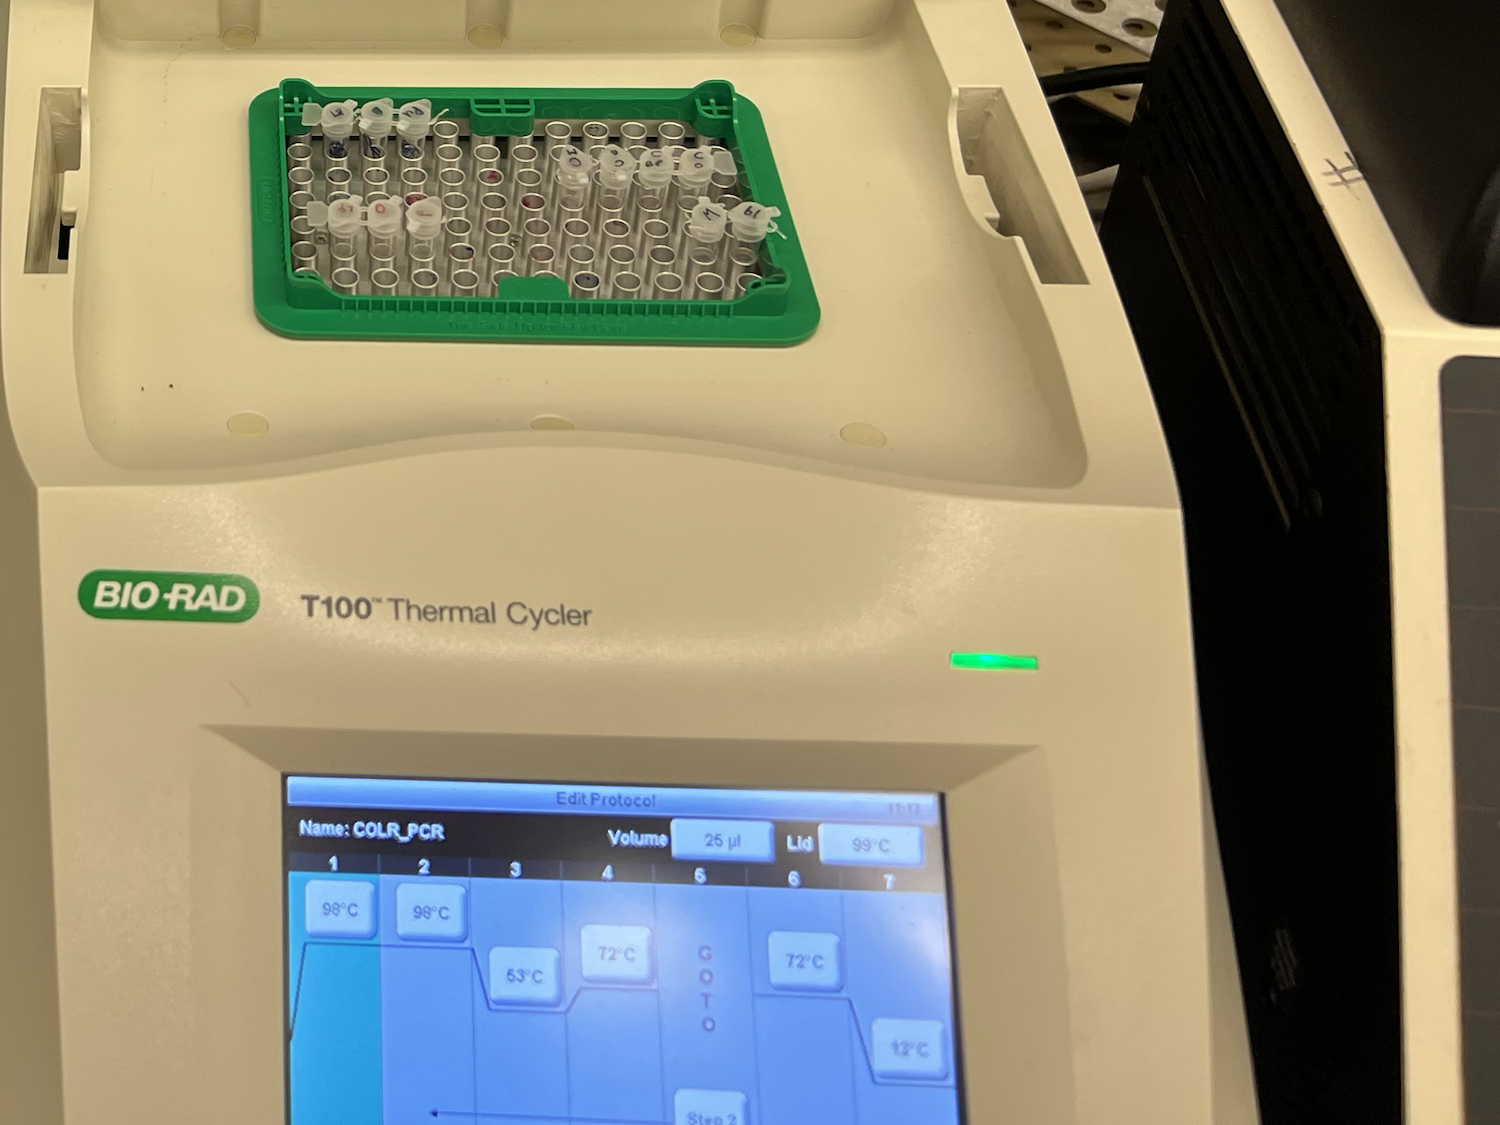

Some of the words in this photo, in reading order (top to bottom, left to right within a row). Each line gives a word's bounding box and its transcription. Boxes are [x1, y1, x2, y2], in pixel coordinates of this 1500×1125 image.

[93, 580, 247, 613] BIO-RAD
[386, 597, 496, 624] Thermal
[506, 601, 593, 630] Cycler
[556, 791, 587, 806] Edit
[590, 792, 657, 808] Protocol
[299, 819, 350, 837] Name:
[607, 829, 669, 848] Volume
[704, 833, 724, 848] 25
[786, 835, 814, 852] Lid
[852, 837, 890, 853] 99°C
[328, 855, 339, 872] 1
[418, 858, 430, 875] 2
[509, 861, 522, 878] 3
[601, 864, 614, 881] 4
[787, 870, 800, 887] 6
[883, 873, 896, 890] 7
